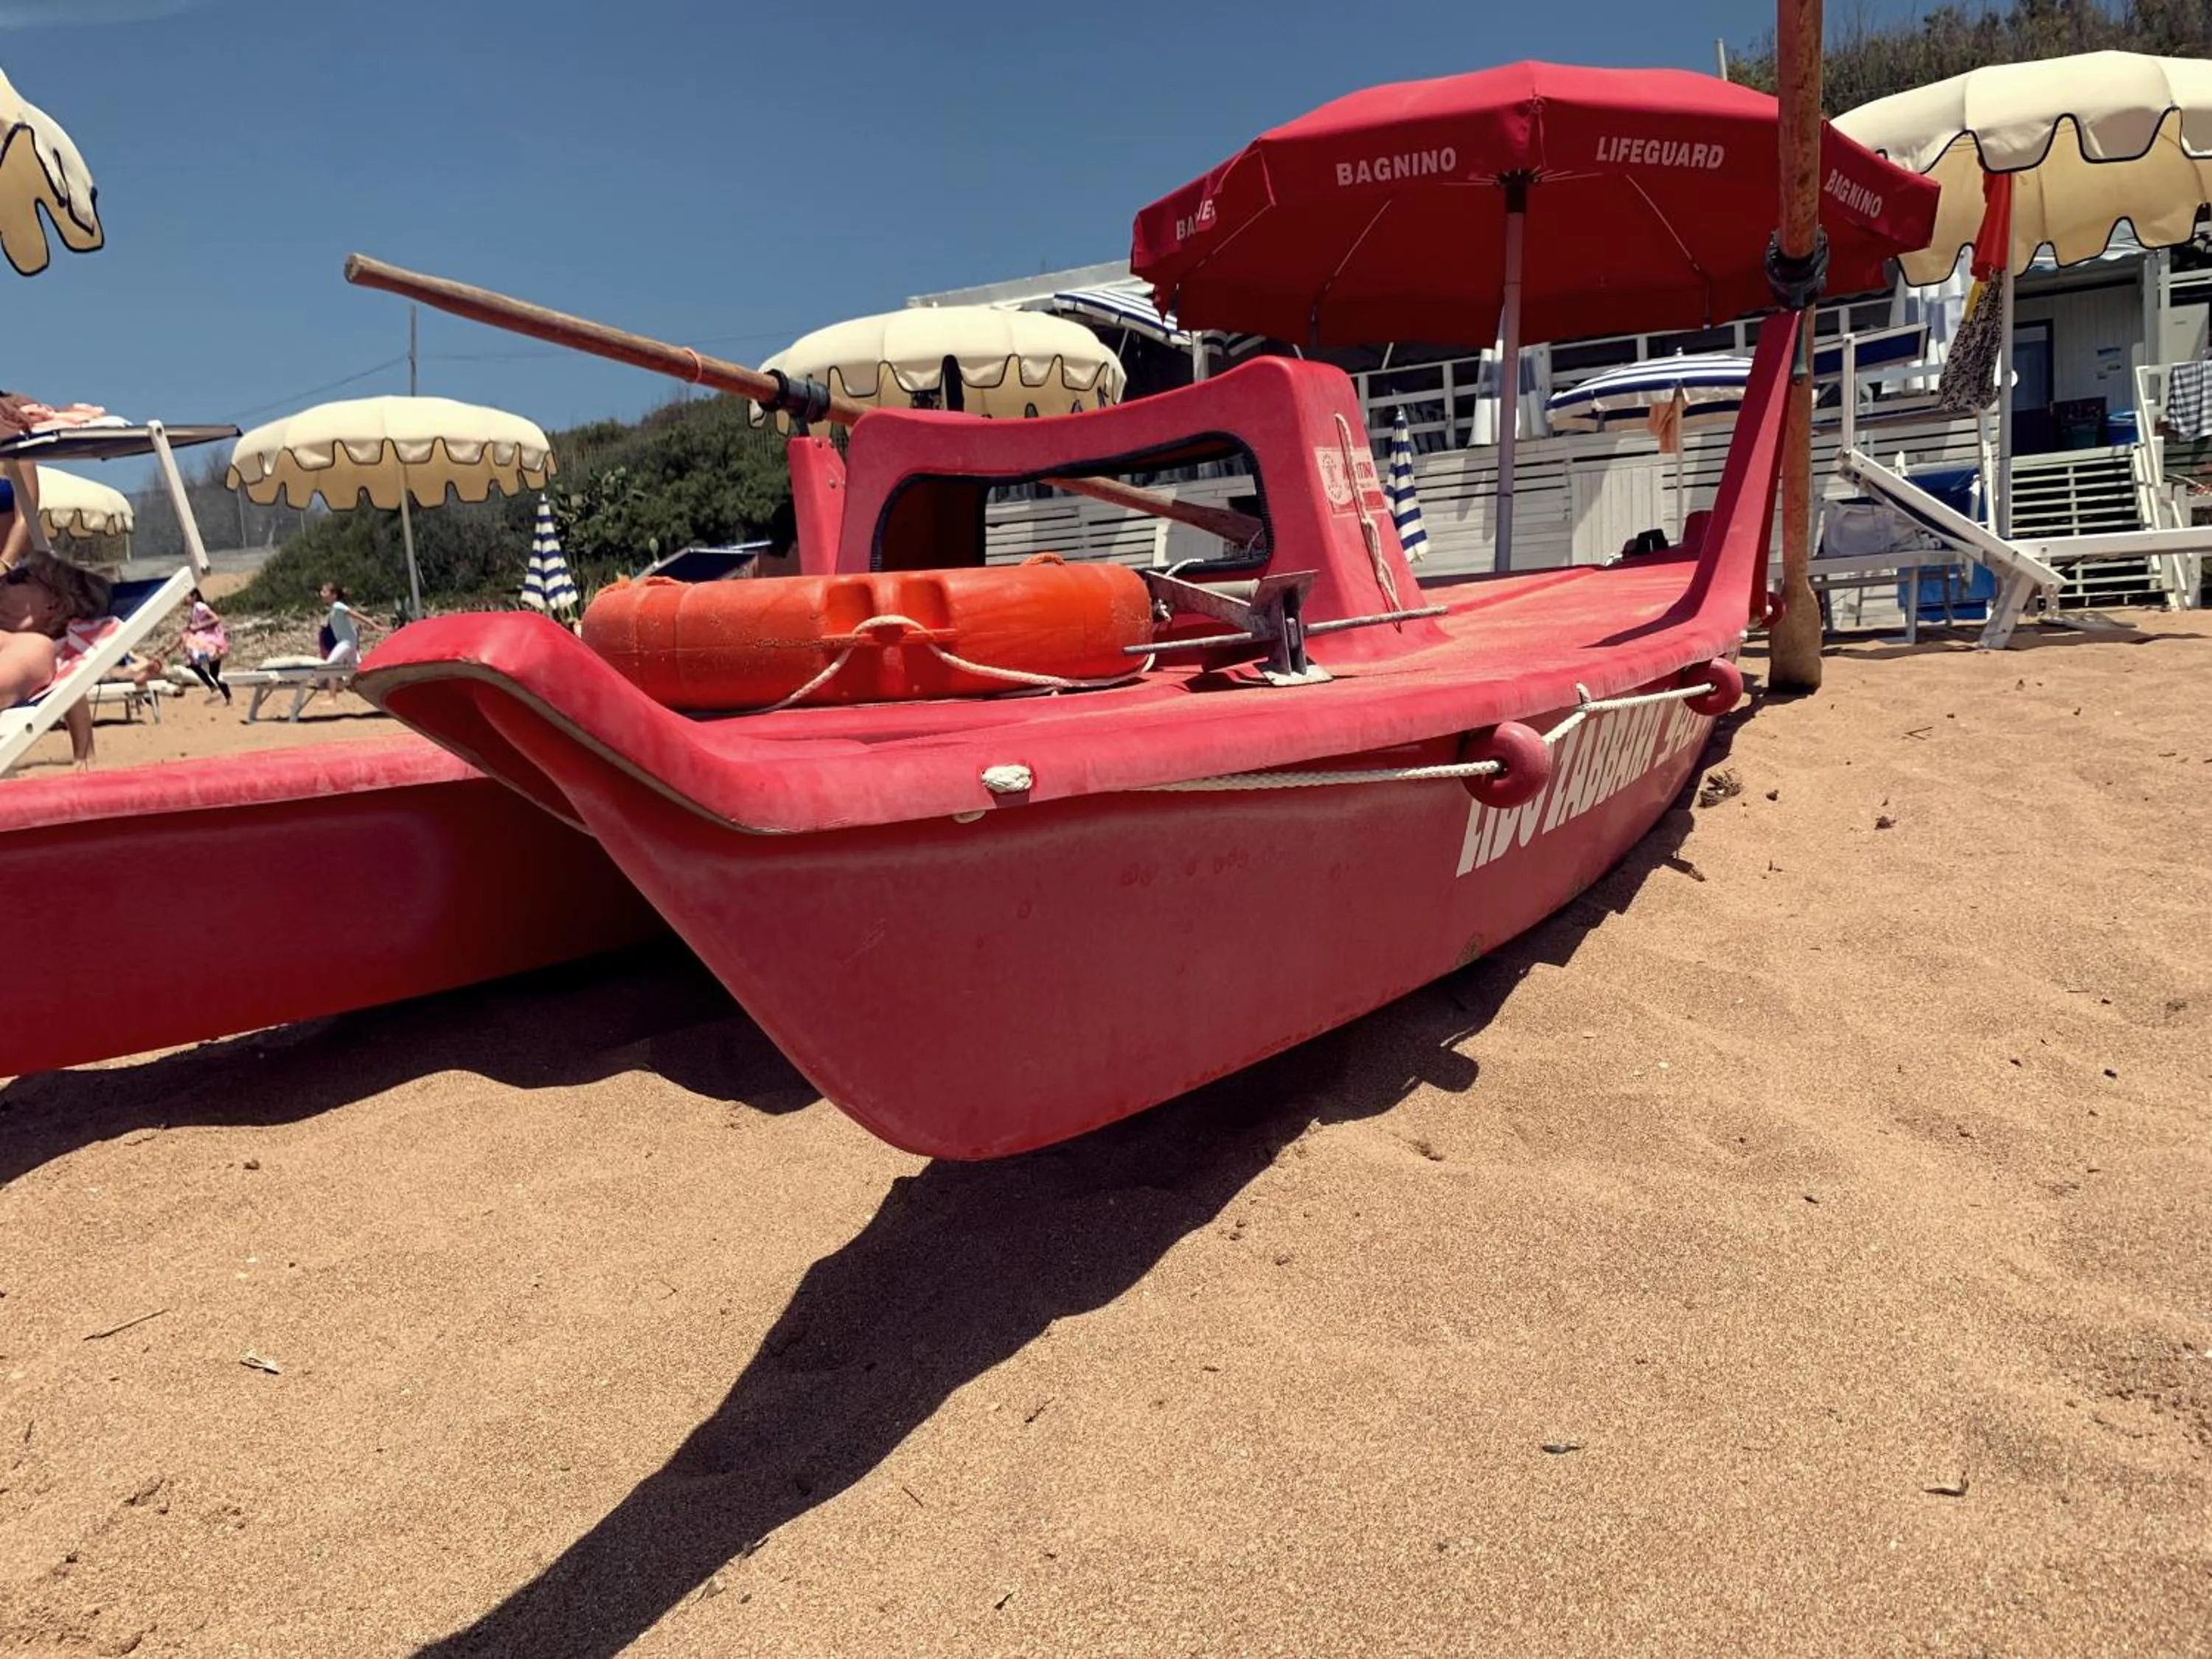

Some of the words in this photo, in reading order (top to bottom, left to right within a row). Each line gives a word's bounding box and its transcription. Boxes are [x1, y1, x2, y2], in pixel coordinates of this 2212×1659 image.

[1336, 147, 1457, 187] BAGNINO
[1596, 136, 1725, 169] LIFEGUARD
[1823, 168, 1883, 218] BAGNINO
